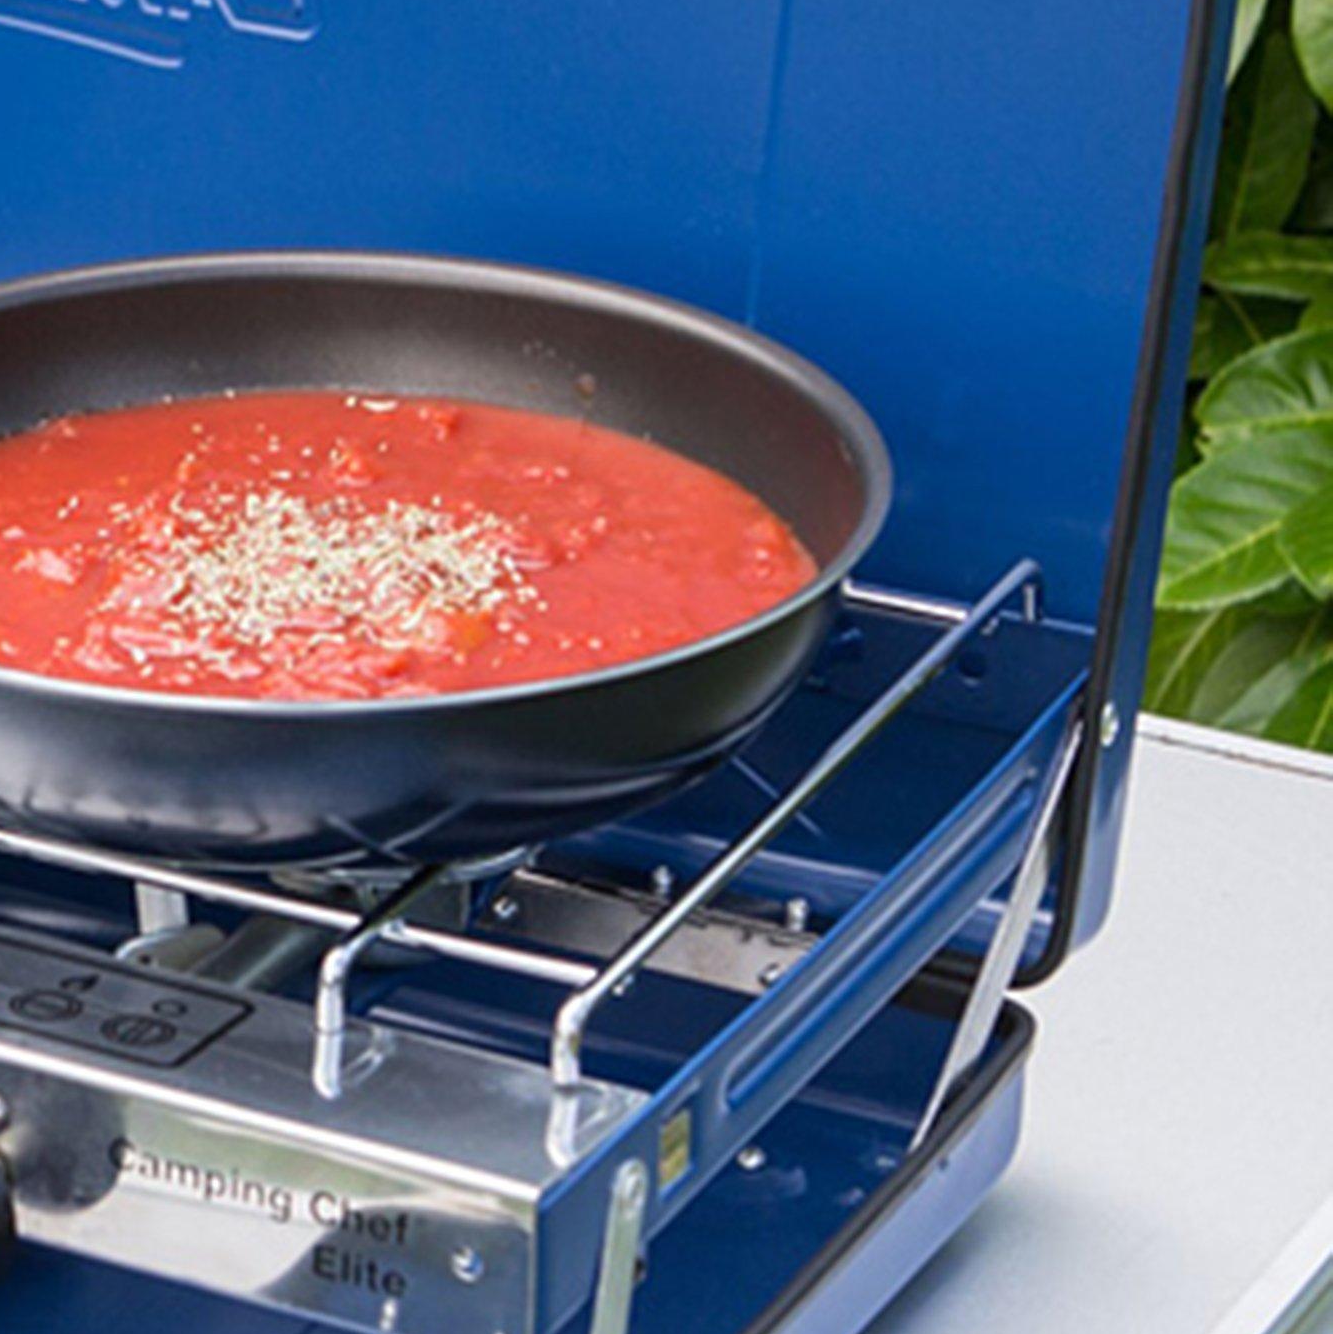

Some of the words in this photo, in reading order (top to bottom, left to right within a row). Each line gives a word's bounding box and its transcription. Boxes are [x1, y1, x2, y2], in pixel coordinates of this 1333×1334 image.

[108, 1136, 293, 1223] Camping
[309, 1189, 409, 1245] Chef
[311, 1243, 407, 1297] Elite
